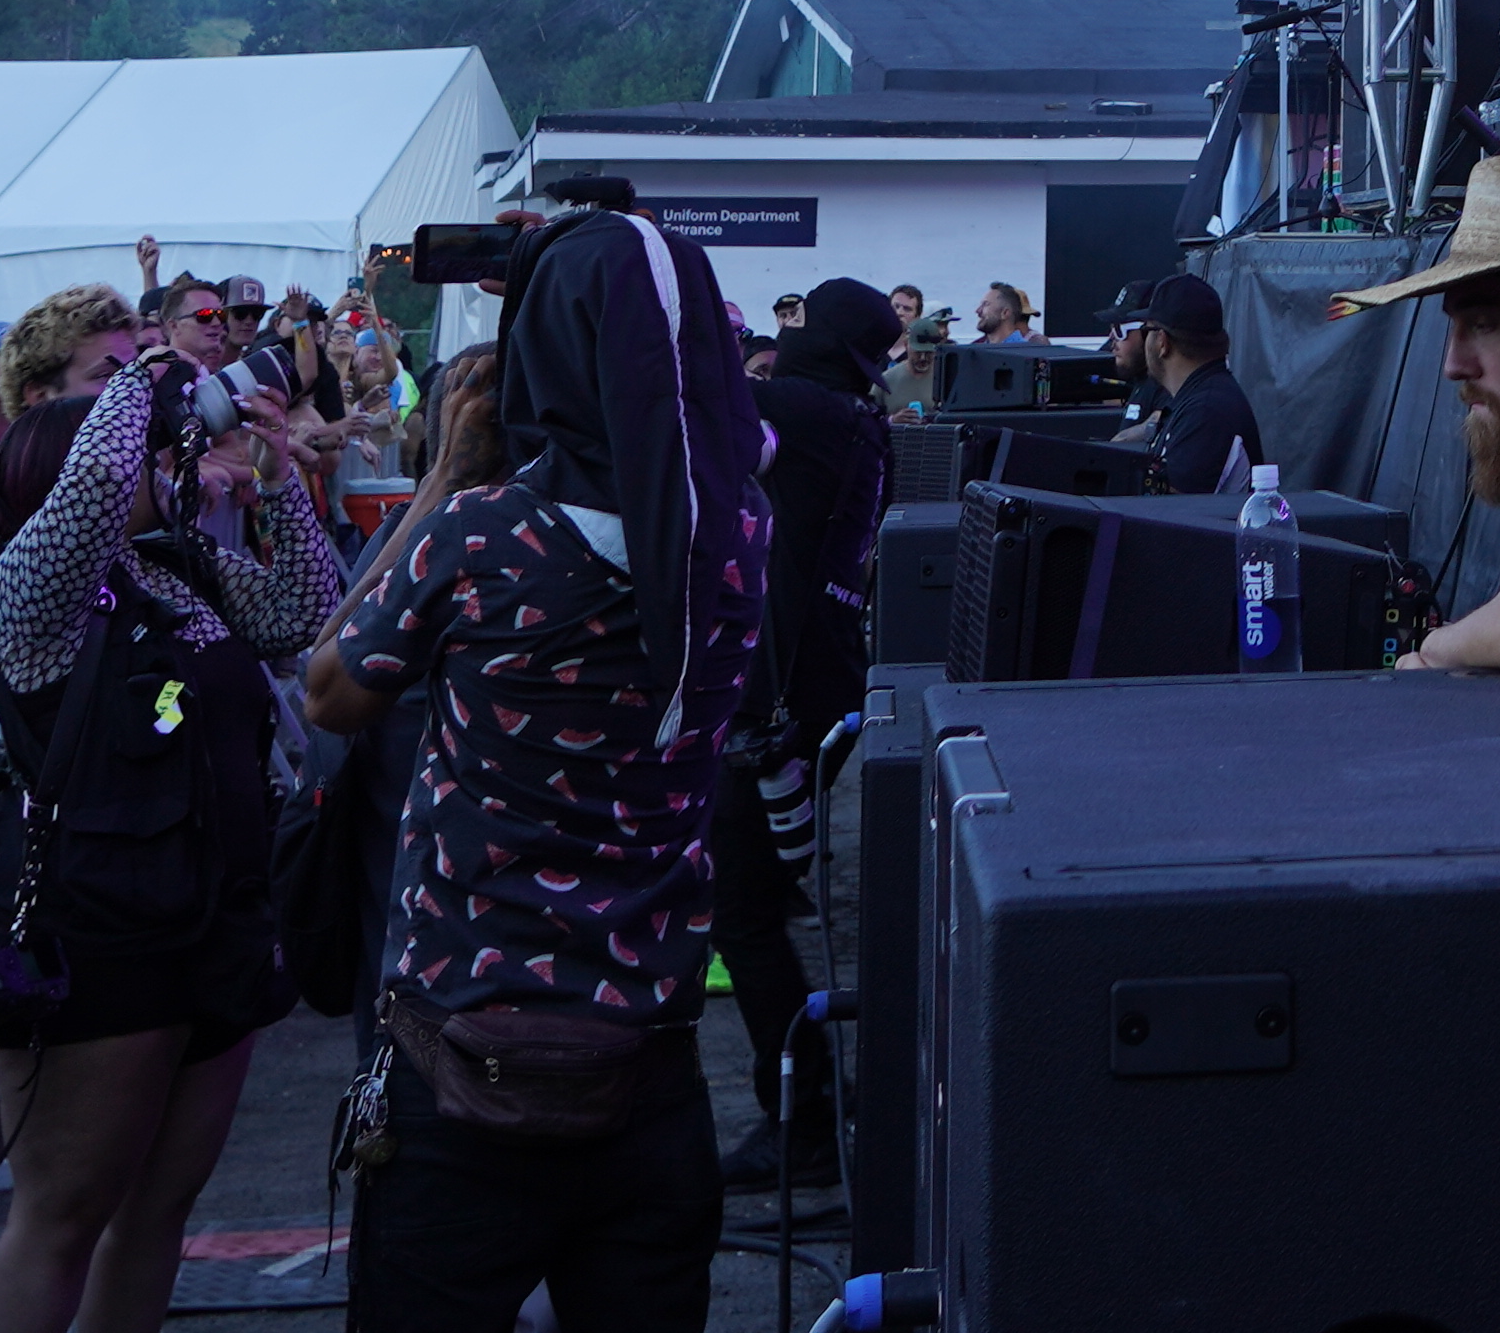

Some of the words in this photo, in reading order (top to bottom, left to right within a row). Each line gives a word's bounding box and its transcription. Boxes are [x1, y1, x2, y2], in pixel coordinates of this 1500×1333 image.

[663, 209, 717, 221] Uniform
[720, 209, 800, 224] Department
[1242, 560, 1264, 647] smart
